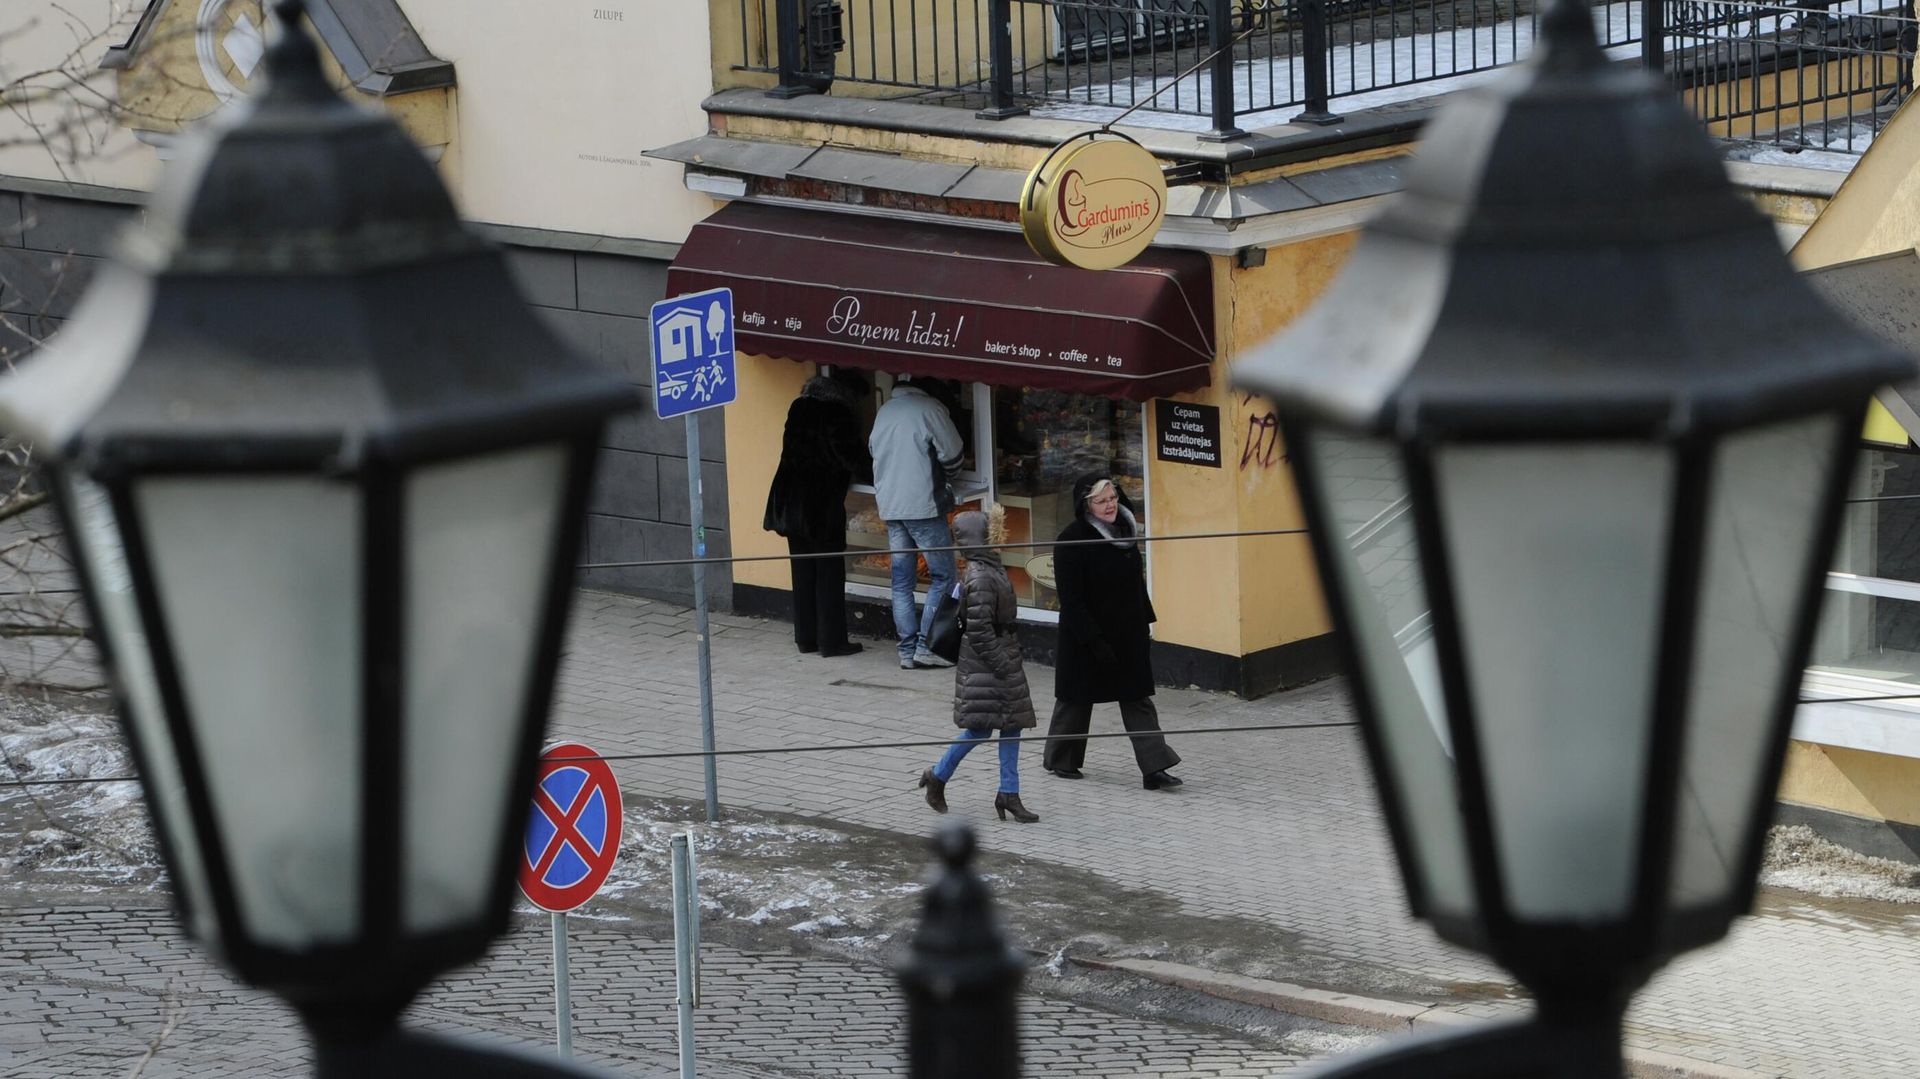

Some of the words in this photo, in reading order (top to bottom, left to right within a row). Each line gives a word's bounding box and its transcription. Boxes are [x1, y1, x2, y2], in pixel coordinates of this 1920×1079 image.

[593, 9, 624, 21] ZILUPE
[1077, 198, 1150, 229] Gardumiņš
[1101, 221, 1132, 245] Pluss
[742, 311, 766, 327] kafija
[785, 316, 802, 331] tēja
[826, 295, 900, 345] Paņem
[905, 309, 965, 349] līdzi!
[985, 340, 1017, 355] baker's
[1018, 344, 1041, 360] shop
[1059, 349, 1088, 363] coffee
[1107, 354, 1122, 367] tea
[1173, 406, 1200, 419] Cepam
[1171, 421, 1181, 430] uz
[1181, 422, 1204, 432] vietas
[1165, 431, 1212, 448] konditorejas
[1162, 444, 1215, 461] izstrādājumus
